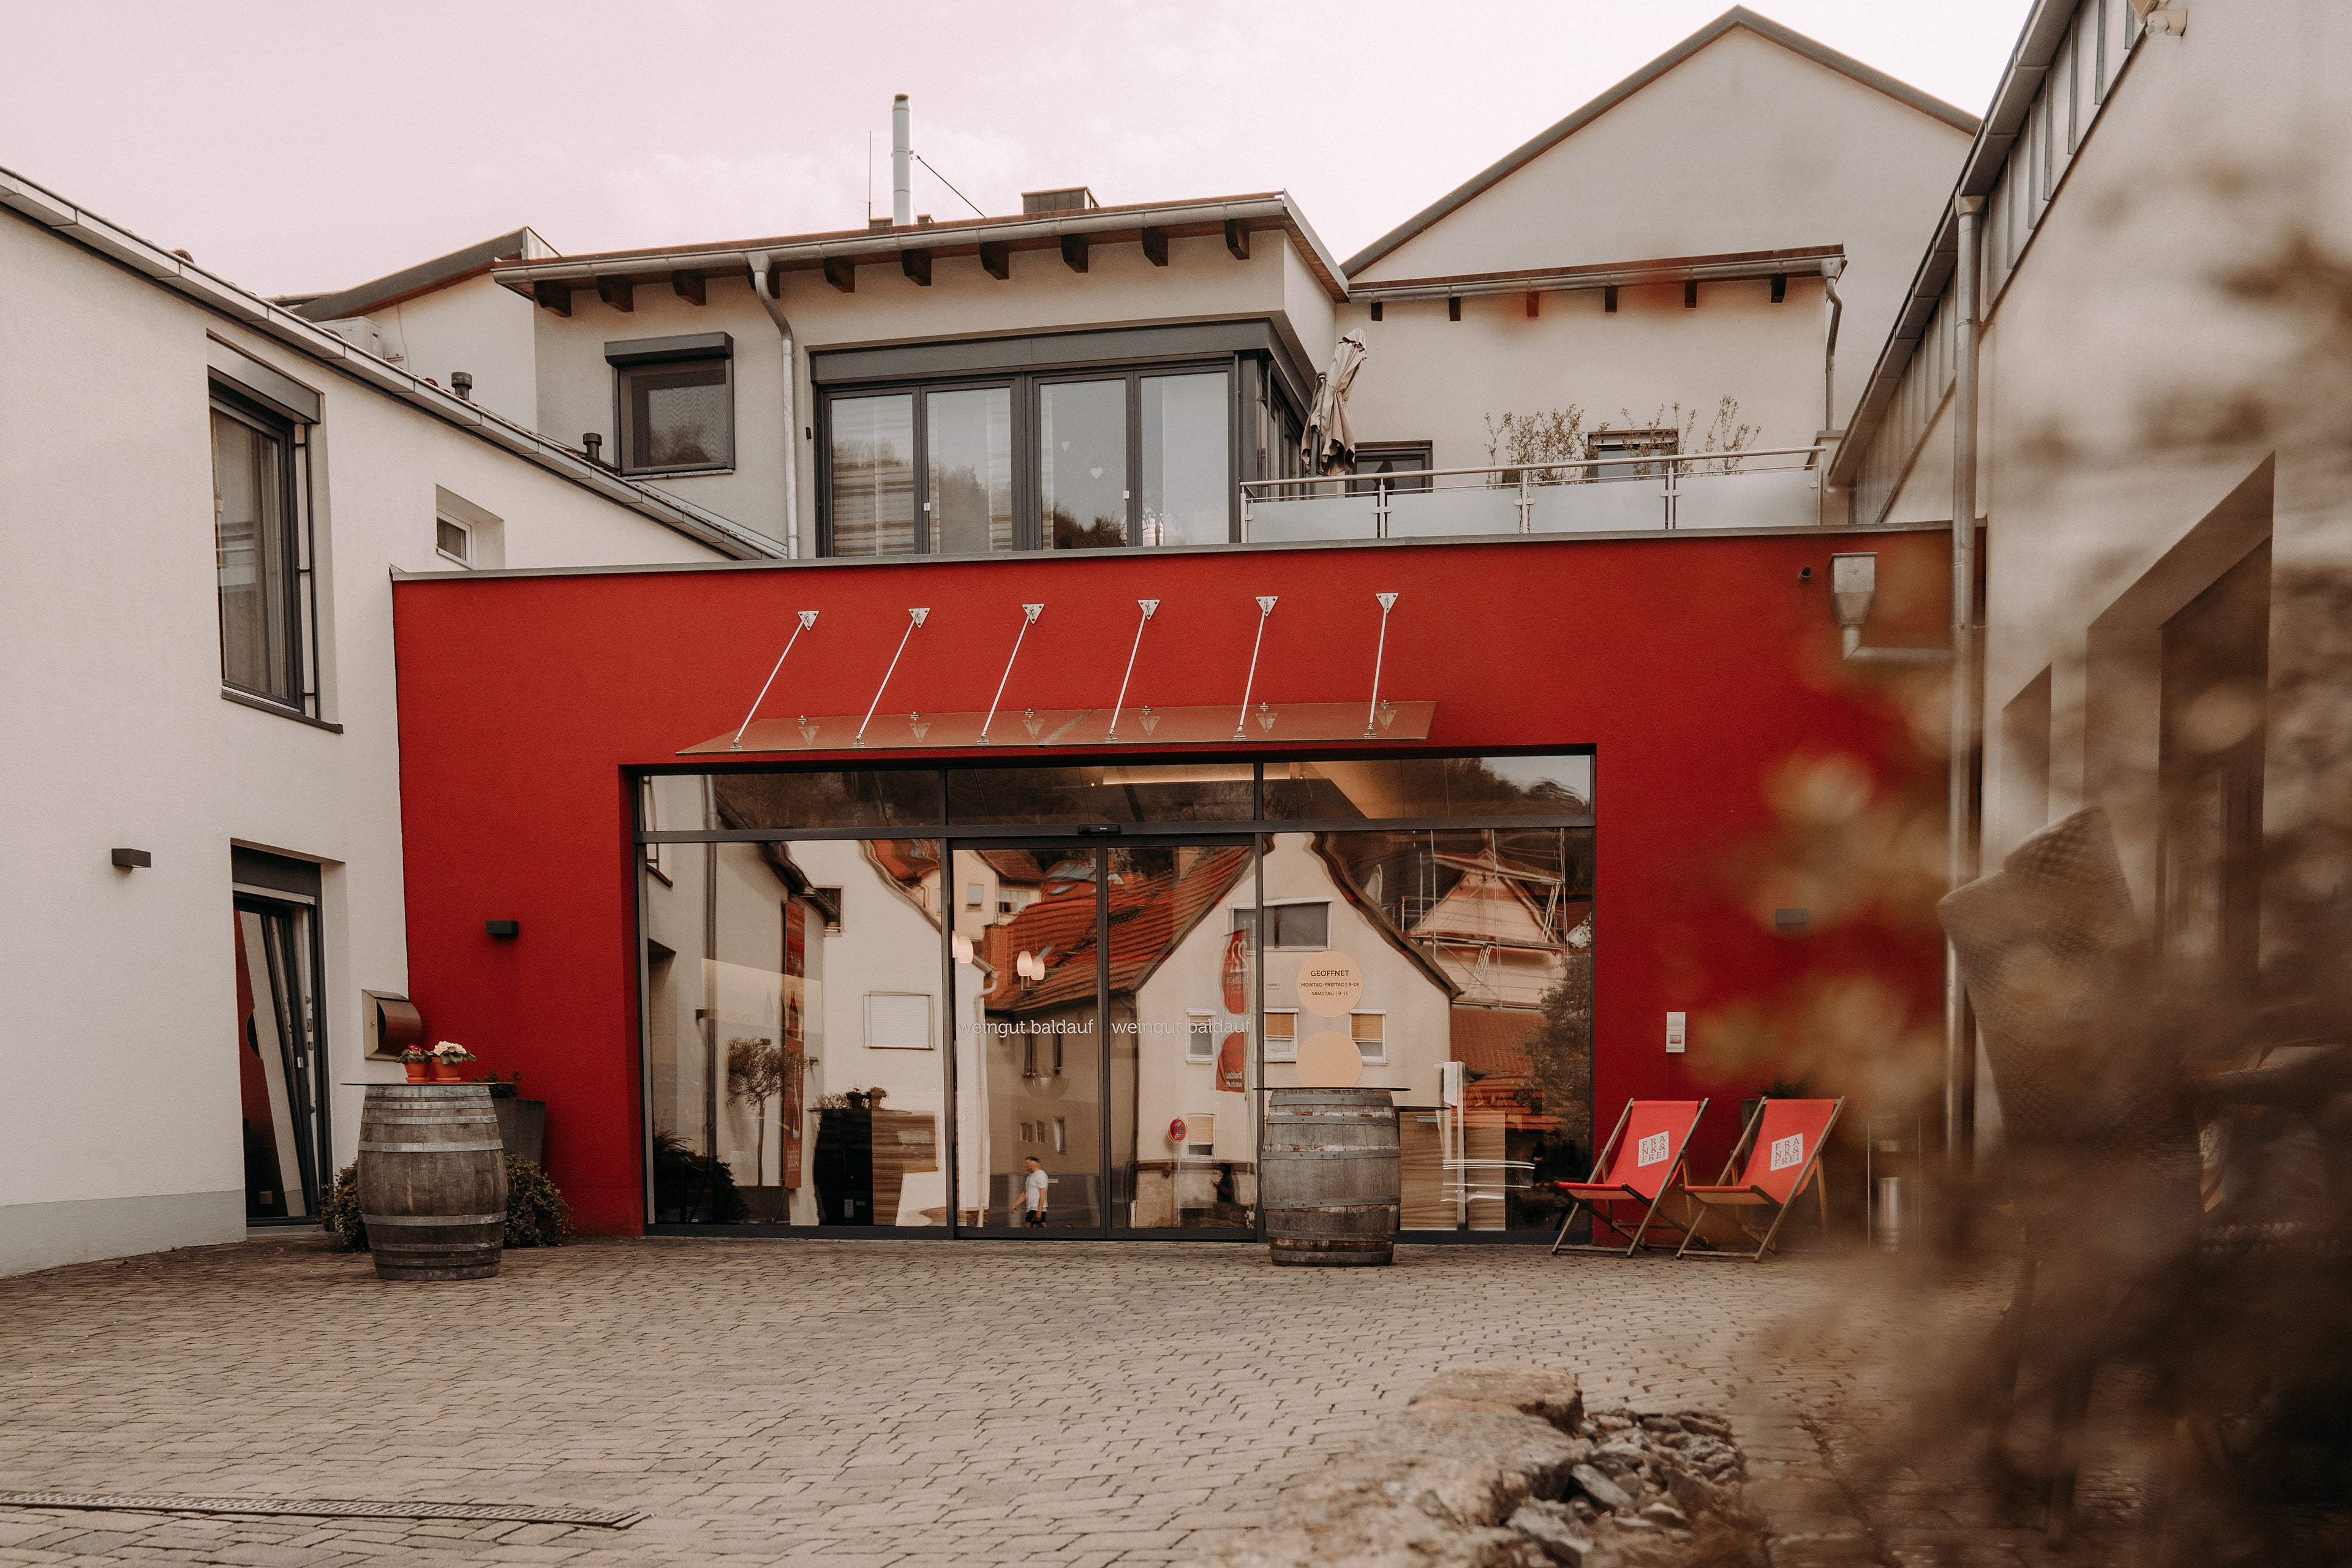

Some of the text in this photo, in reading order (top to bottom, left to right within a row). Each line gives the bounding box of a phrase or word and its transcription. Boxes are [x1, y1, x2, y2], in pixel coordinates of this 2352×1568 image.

[959, 1019, 1094, 1038] weingut baldauf
[1111, 1019, 1252, 1037] weingut baldauf
[1642, 1136, 1665, 1148] FRA
[1775, 1138, 1800, 1151] FRA
[1642, 1143, 1665, 1156] NK&
[1775, 1146, 1799, 1159] NK&
[1642, 1150, 1665, 1163] FREI
[1774, 1153, 1799, 1166] FREI
